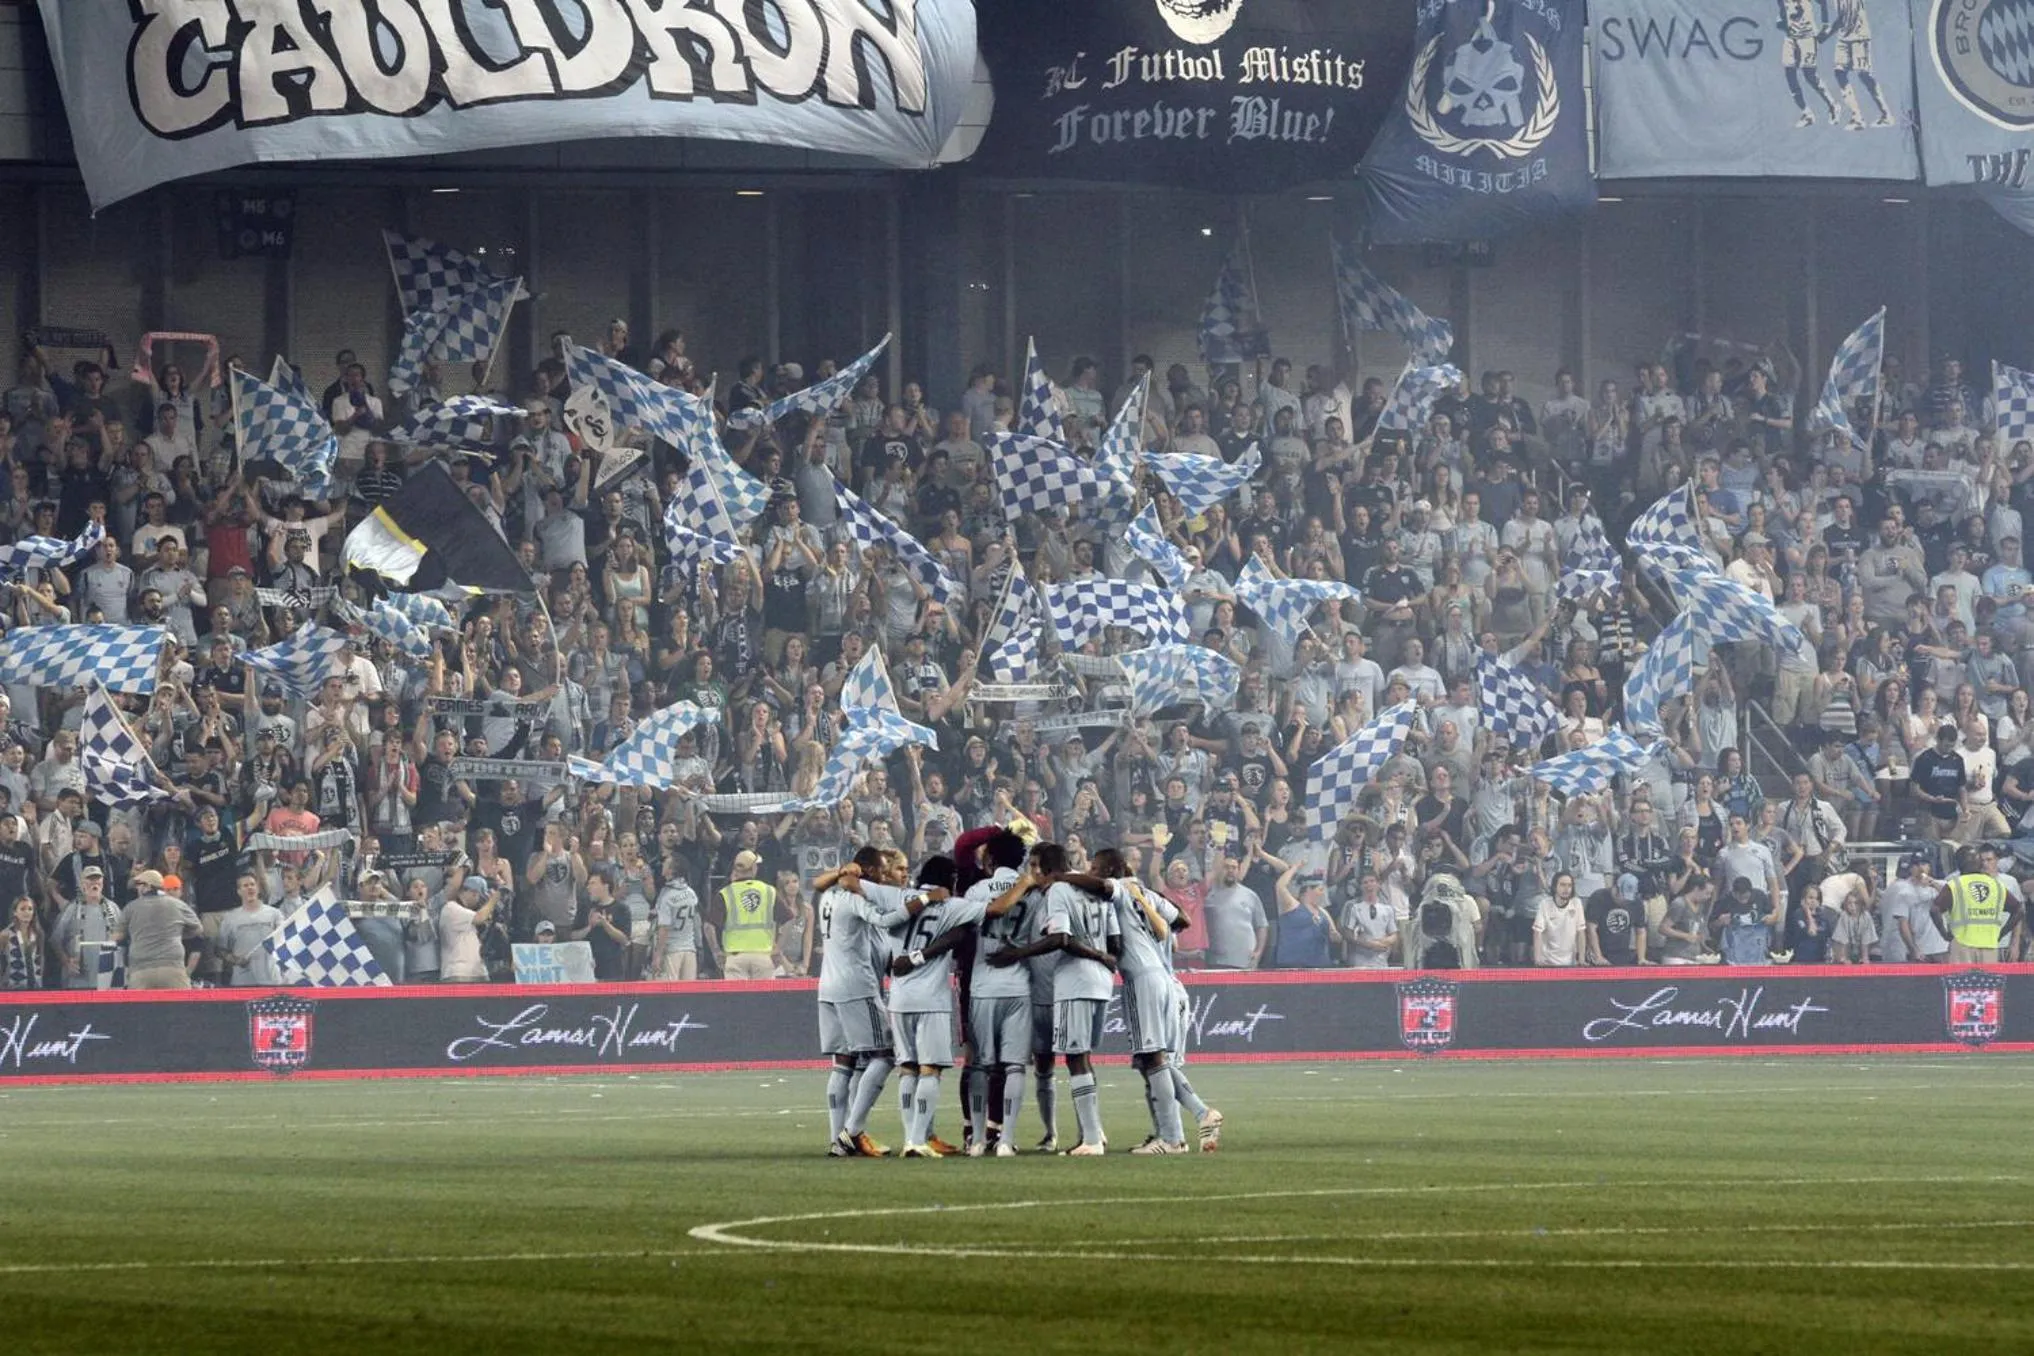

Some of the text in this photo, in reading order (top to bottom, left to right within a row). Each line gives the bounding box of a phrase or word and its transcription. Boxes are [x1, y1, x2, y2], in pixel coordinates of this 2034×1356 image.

[1601, 16, 1764, 61] SWAG
[1102, 45, 1225, 90] Futbol
[1239, 48, 1366, 90] Misfits
[1047, 95, 1335, 154] Forever Blue!
[1415, 155, 1549, 194] MILITIA
[591, 1003, 709, 1057] Hunt
[1718, 985, 1829, 1038] Hunt
